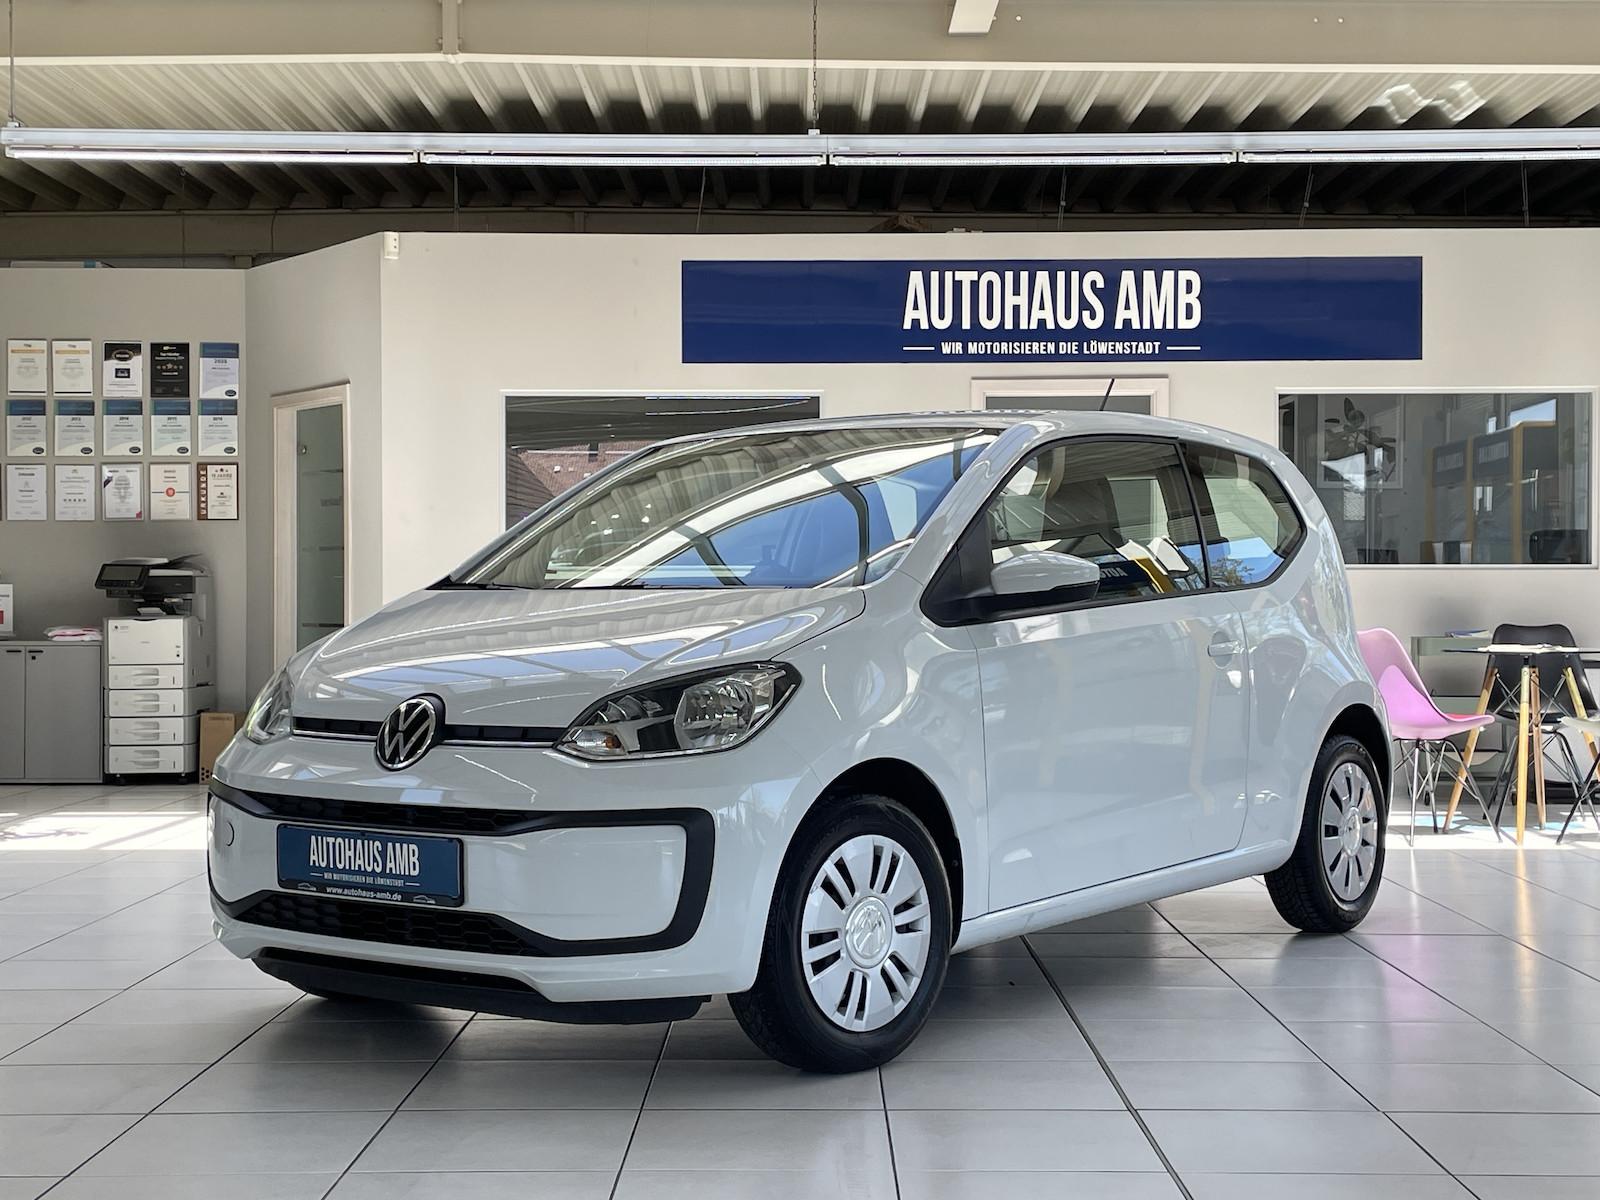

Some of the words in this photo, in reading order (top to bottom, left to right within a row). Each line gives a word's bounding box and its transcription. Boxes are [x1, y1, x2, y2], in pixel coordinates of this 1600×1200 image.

[902, 270, 1105, 330] AUTOHAUS
[1113, 269, 1202, 330] AMB
[941, 342, 963, 354] WIR
[967, 342, 1055, 354] MOTORISIEREN
[1059, 342, 1080, 354] DIE
[1083, 339, 1161, 354] LÖWENSTADT
[309, 835, 383, 873] AUTOHAUS
[385, 842, 420, 876] AMB
[326, 887, 402, 901] www.autohaus-amb.de
